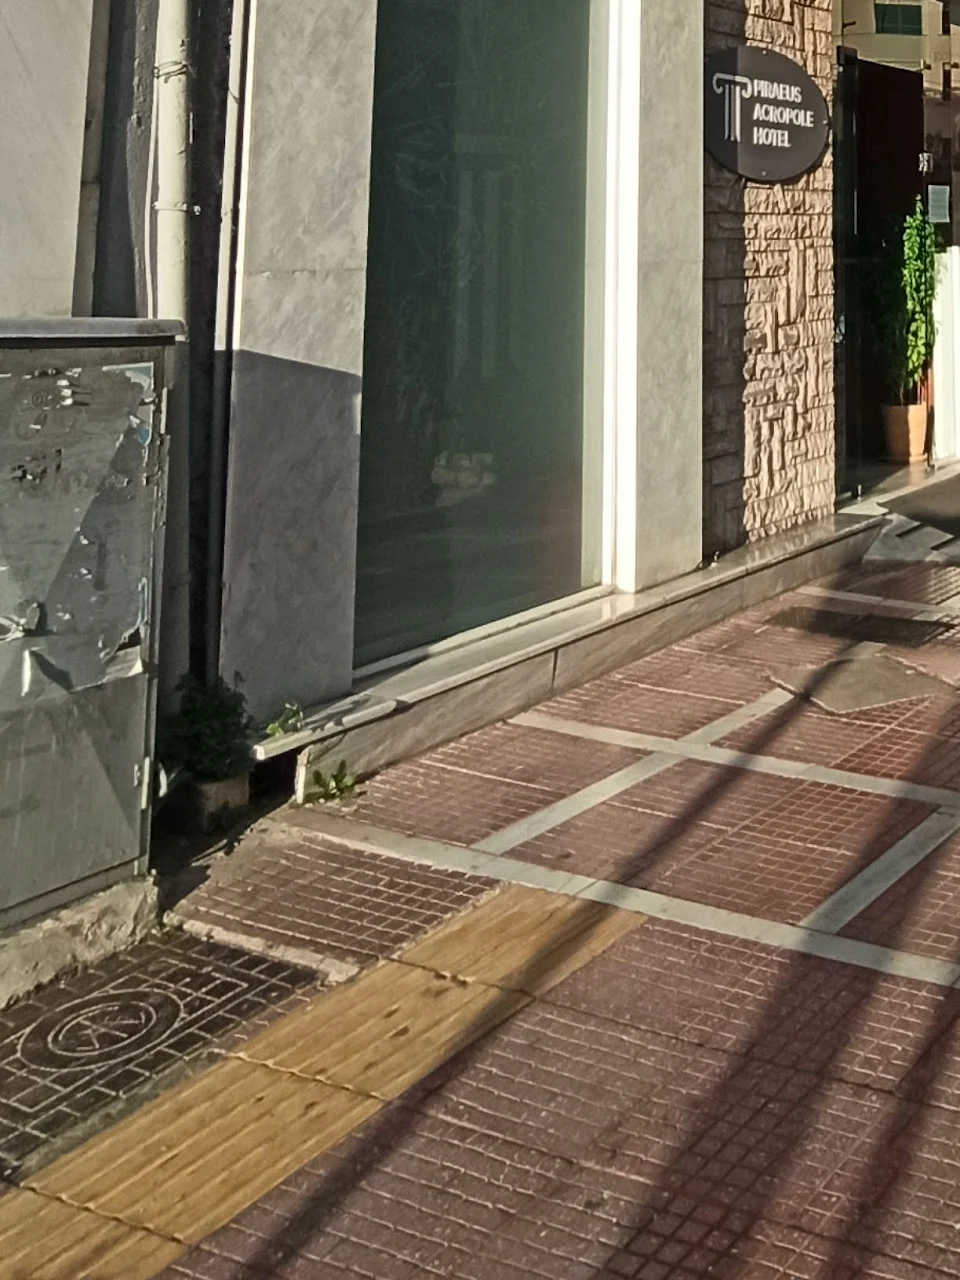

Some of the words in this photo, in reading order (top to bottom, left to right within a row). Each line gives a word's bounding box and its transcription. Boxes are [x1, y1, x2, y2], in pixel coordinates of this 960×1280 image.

[753, 79, 802, 103] PIRAEUS
[753, 103, 814, 127] ACROPOLE
[753, 126, 791, 147] HOTEL
